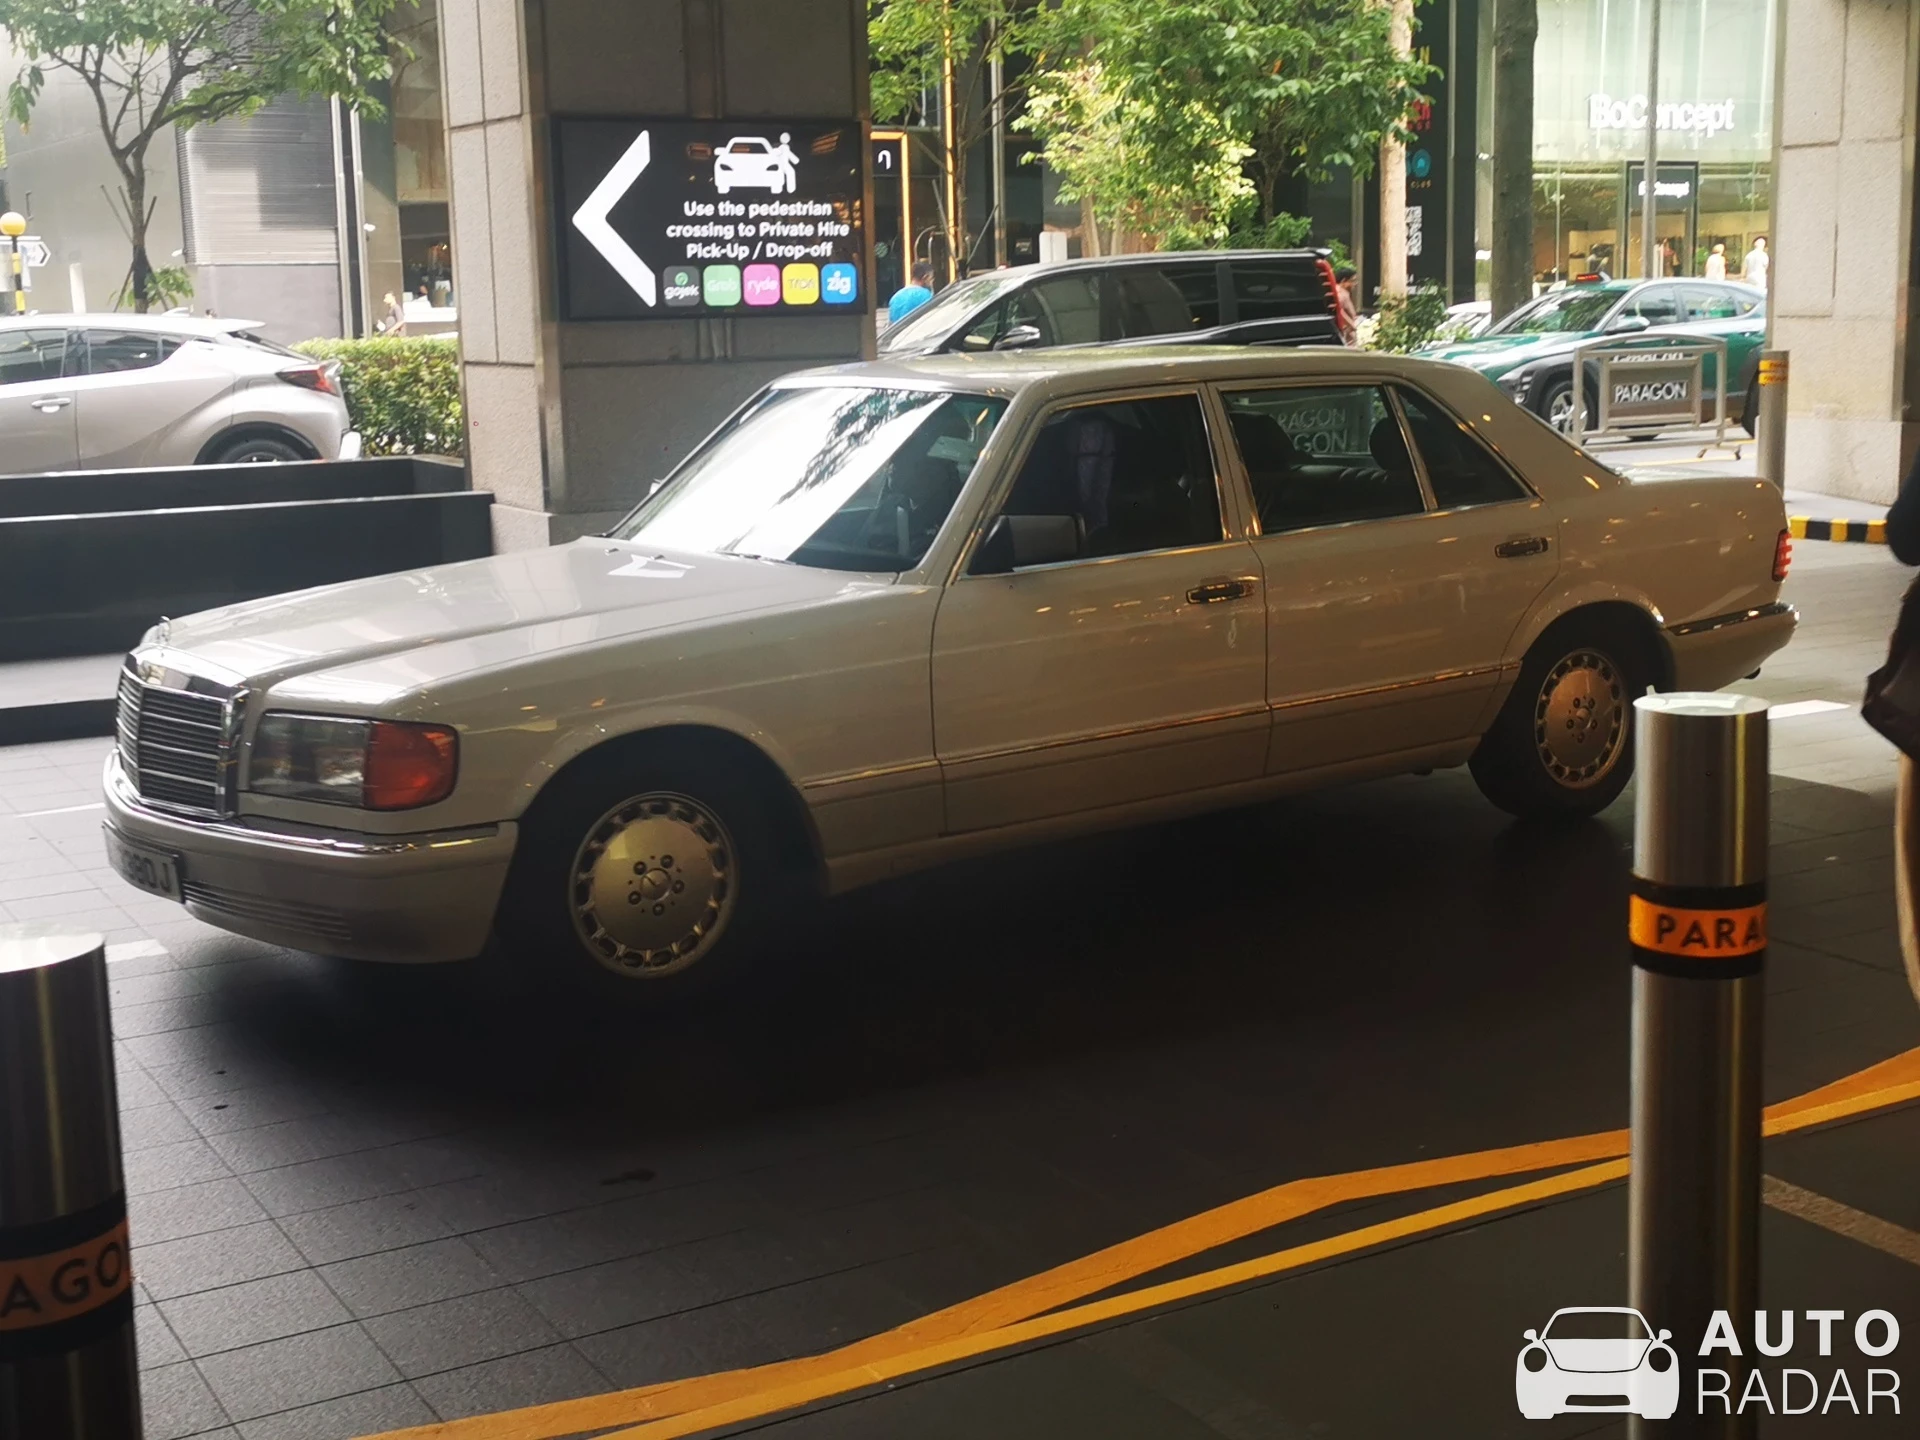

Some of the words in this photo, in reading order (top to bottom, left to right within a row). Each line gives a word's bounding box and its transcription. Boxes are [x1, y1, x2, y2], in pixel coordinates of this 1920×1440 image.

[683, 200, 715, 217] Use
[718, 200, 746, 217] the
[748, 200, 833, 219] pedestrian
[665, 221, 735, 240] crossing
[737, 222, 756, 237] to
[759, 221, 815, 237] Private
[817, 221, 850, 237] Hire
[686, 242, 750, 261] Pick-Up
[751, 241, 763, 261] /
[765, 241, 834, 261] Drop-off
[663, 284, 700, 300] gojek
[706, 279, 738, 293] Grab
[746, 277, 779, 295] ryde
[826, 270, 852, 295] zig
[1614, 381, 1688, 403] PARAGON
[1276, 408, 1347, 432] RAGON
[0, 1238, 129, 1318] AGO
